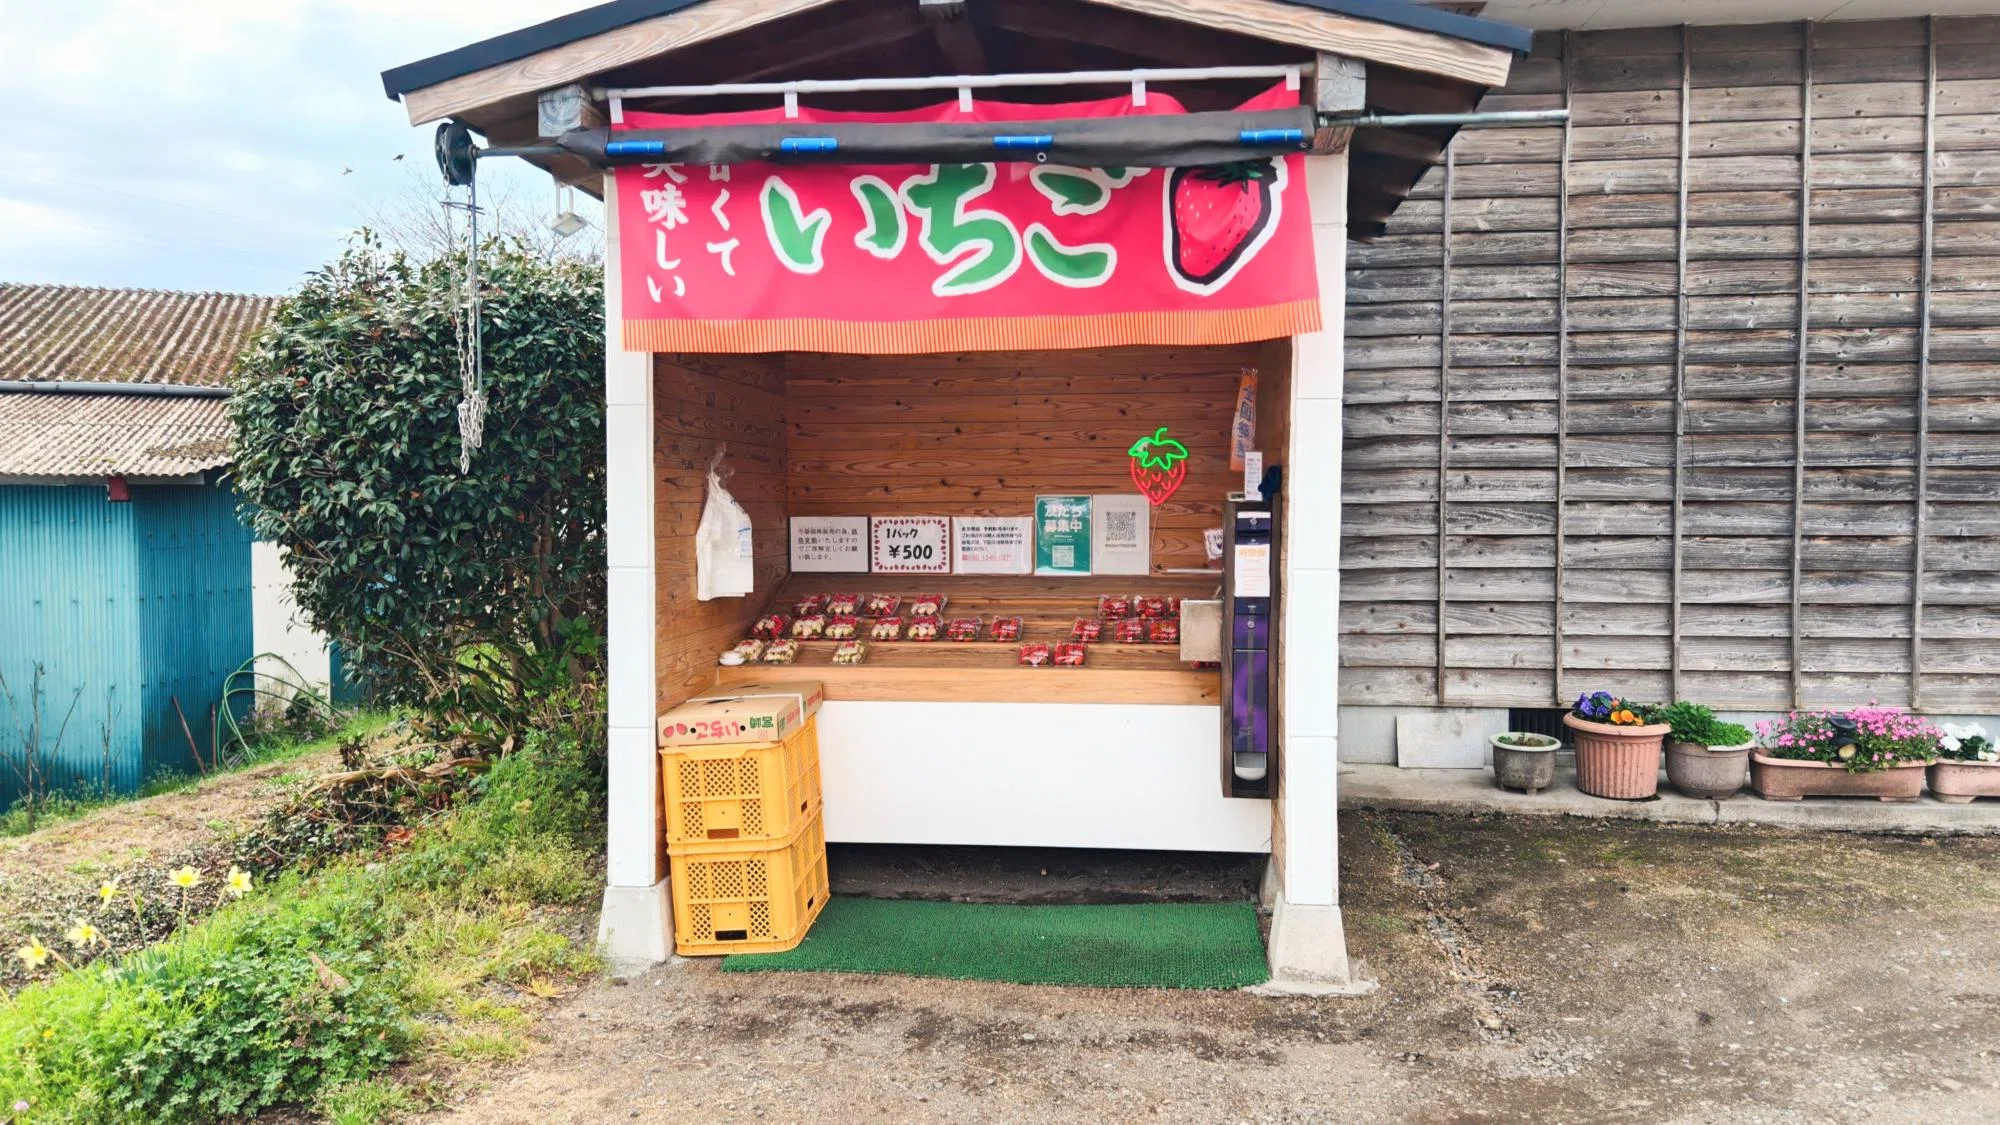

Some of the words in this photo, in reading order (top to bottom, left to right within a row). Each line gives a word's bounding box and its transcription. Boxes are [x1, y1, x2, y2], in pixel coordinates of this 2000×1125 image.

[759, 163, 1150, 297] いちご
[1045, 519, 1082, 532] 募集中
[886, 528, 918, 540] 1パック
[889, 544, 933, 560] ¥500
[695, 720, 740, 740] いちご
